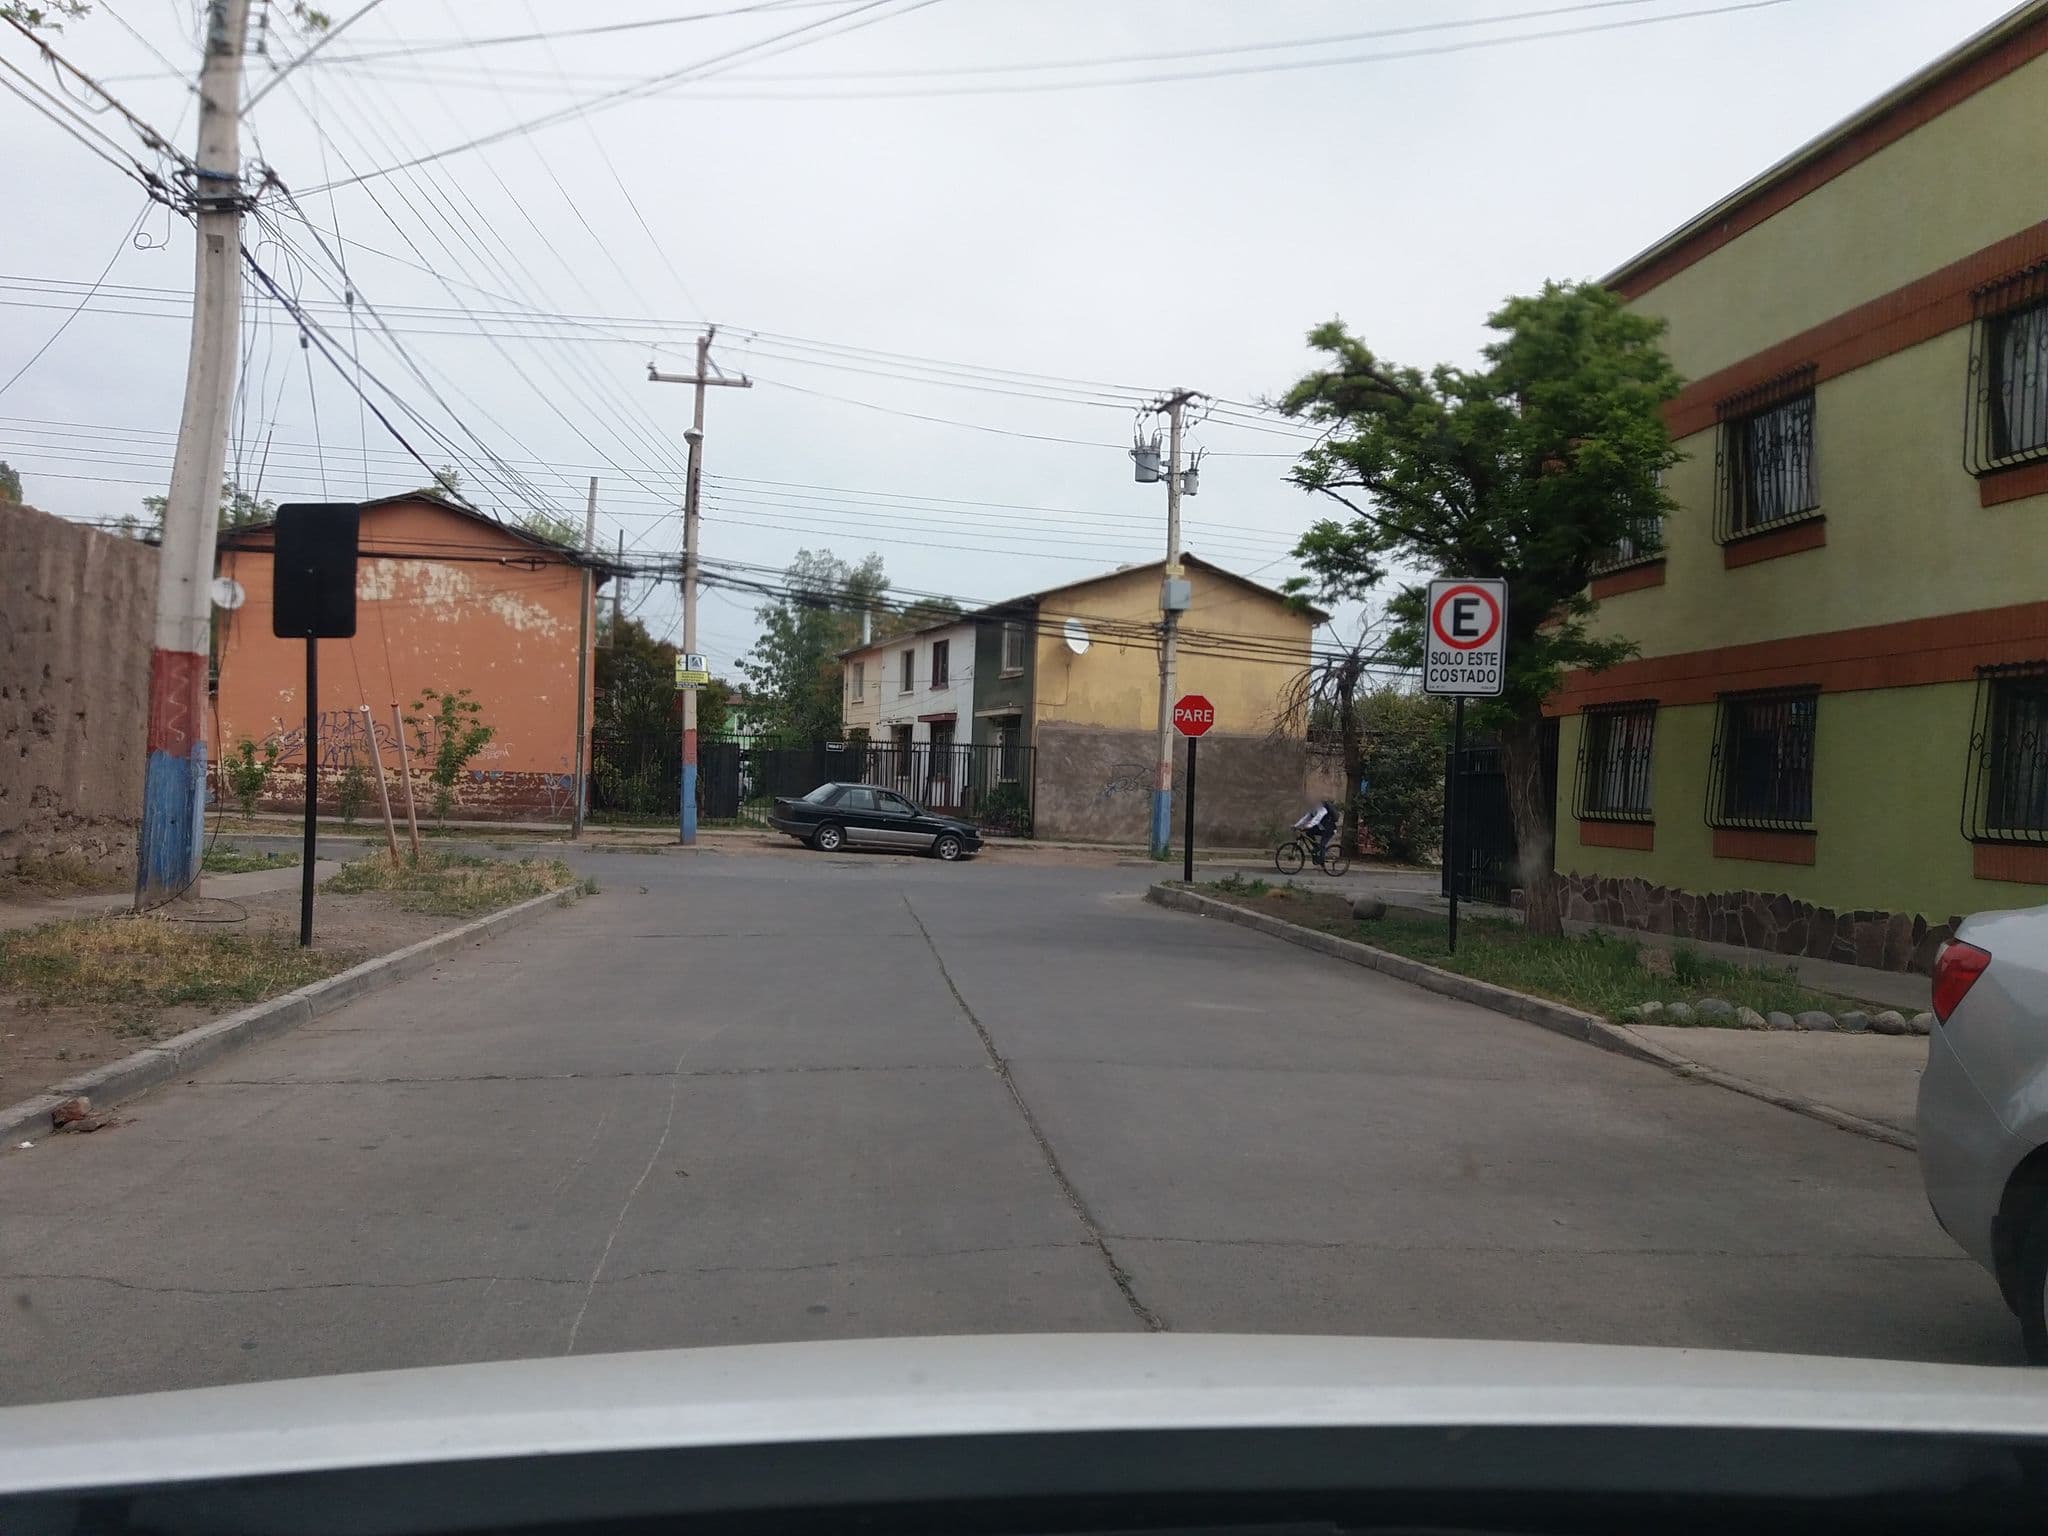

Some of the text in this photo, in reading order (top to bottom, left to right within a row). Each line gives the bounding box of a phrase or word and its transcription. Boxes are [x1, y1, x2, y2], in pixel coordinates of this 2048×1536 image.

[1453, 598, 1480, 636] E
[1431, 652, 1498, 666] SOLO ESTE
[1430, 668, 1496, 683] COSTADO
[1175, 709, 1212, 722] PARE
